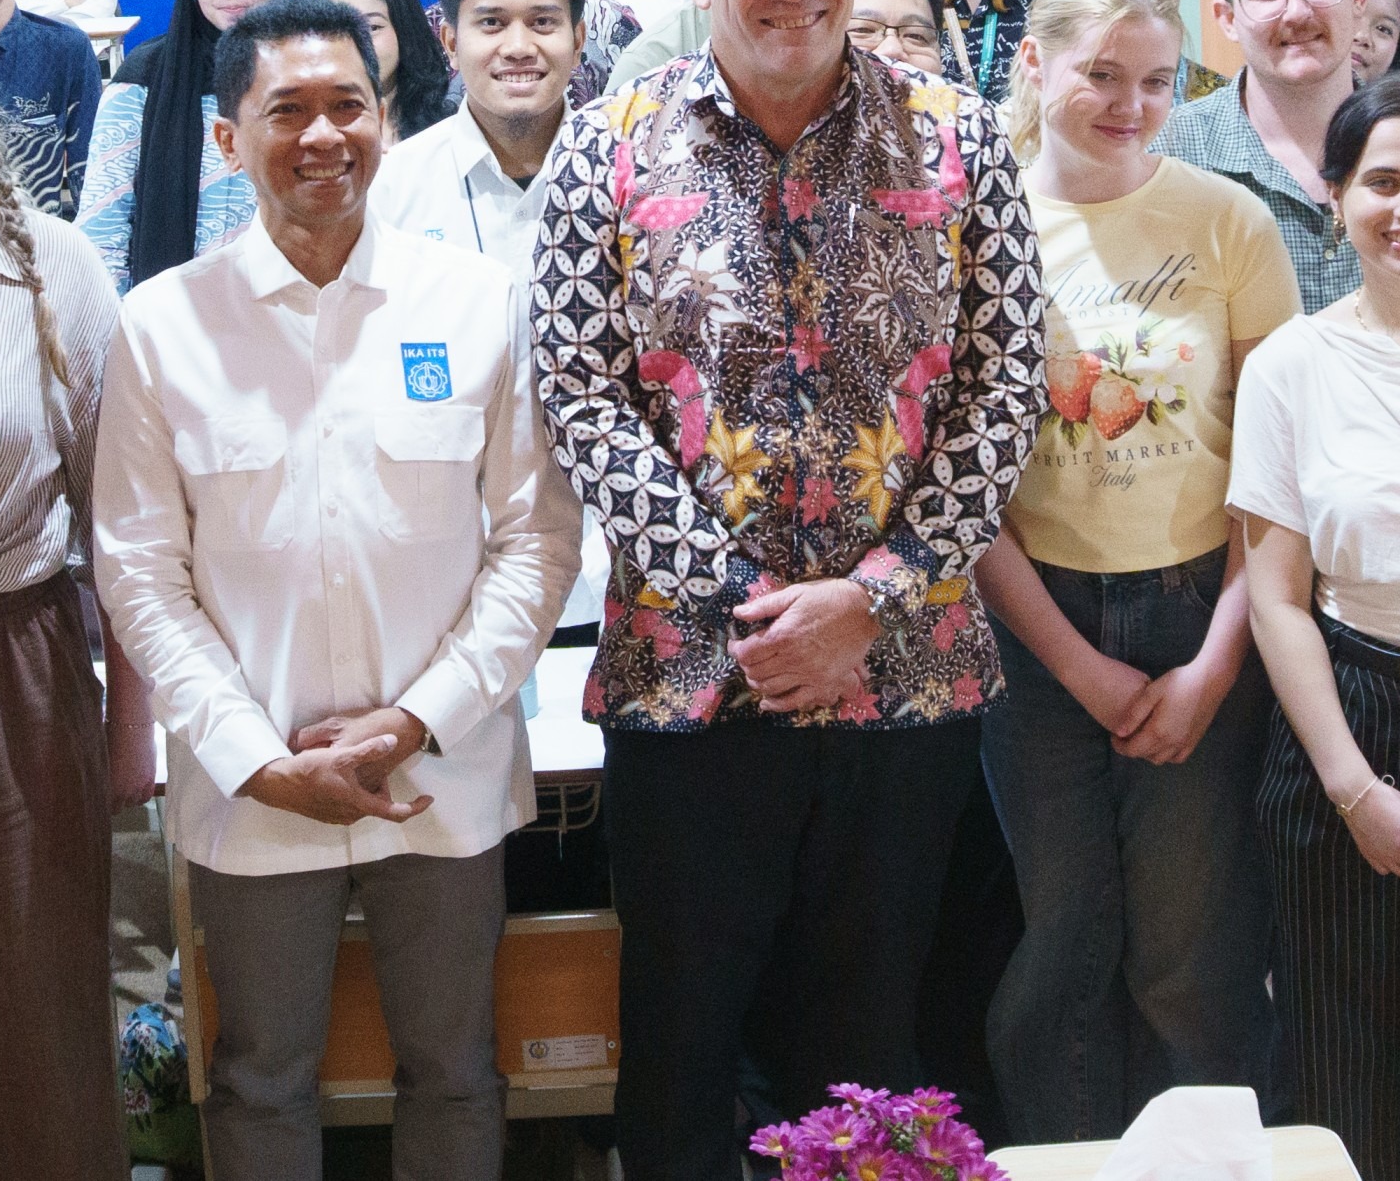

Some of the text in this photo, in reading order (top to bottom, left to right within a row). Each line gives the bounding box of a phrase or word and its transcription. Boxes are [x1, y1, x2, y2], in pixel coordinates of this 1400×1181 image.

[1045, 252, 1196, 318] Amalfi
[404, 348, 445, 358] IKA ITS
[1033, 438, 1196, 467] FRUIT MARKET
[1089, 463, 1137, 492] Italy
